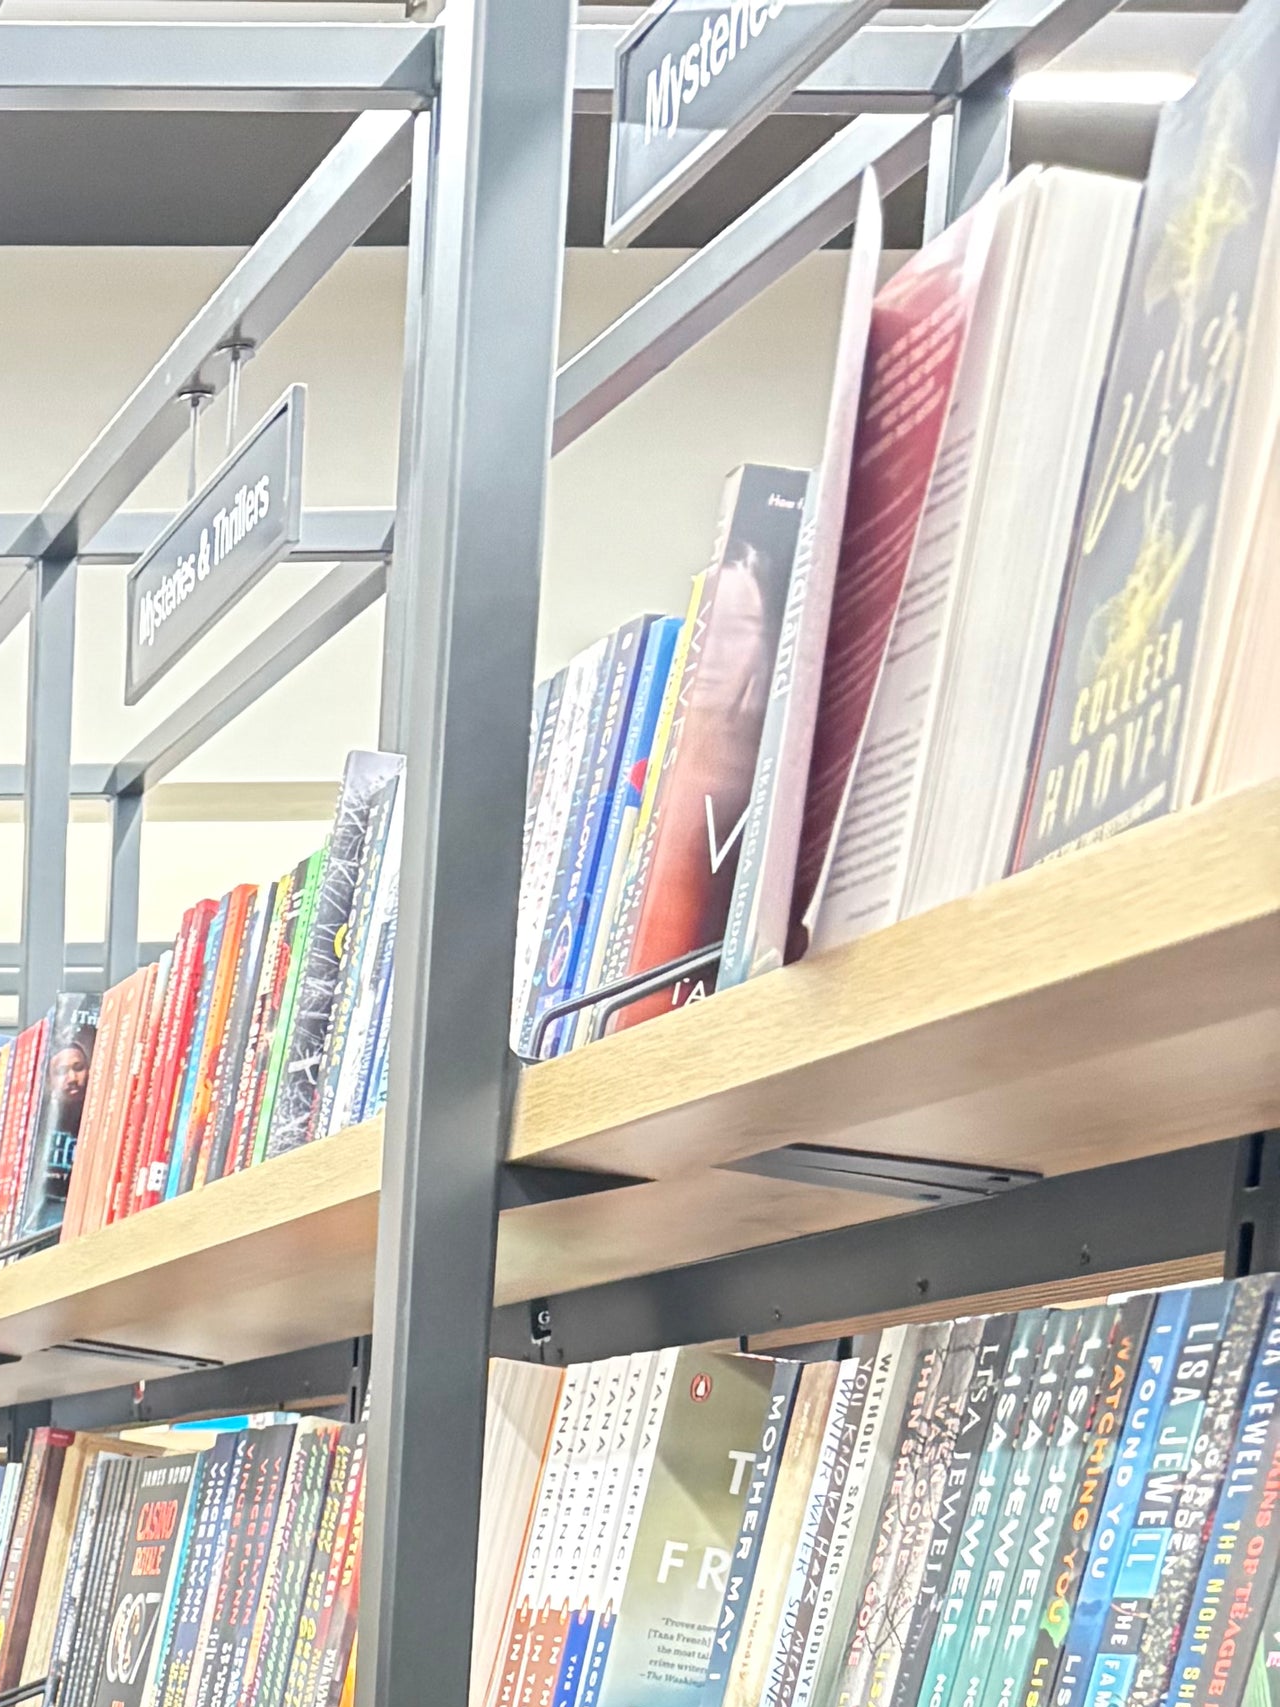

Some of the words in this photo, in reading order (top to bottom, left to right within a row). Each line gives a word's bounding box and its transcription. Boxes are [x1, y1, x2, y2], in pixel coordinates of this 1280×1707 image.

[139, 554, 195, 646] Mysteries
[197, 528, 210, 581] &
[213, 474, 270, 566] Thrillers
[600, 661, 624, 762] JESSICA
[568, 763, 599, 900] FELLOWES
[1055, 1340, 1103, 1449] LISA
[136, 1499, 178, 1542] CASINO
[737, 1394, 785, 1561] MOTHER
[1003, 1464, 1067, 1654] JEWELL
[1214, 1518, 1241, 1567] THE
[106, 1591, 163, 1685] 007
[714, 1576, 744, 1655] MAY
[1191, 1577, 1225, 1656] NIGHT
